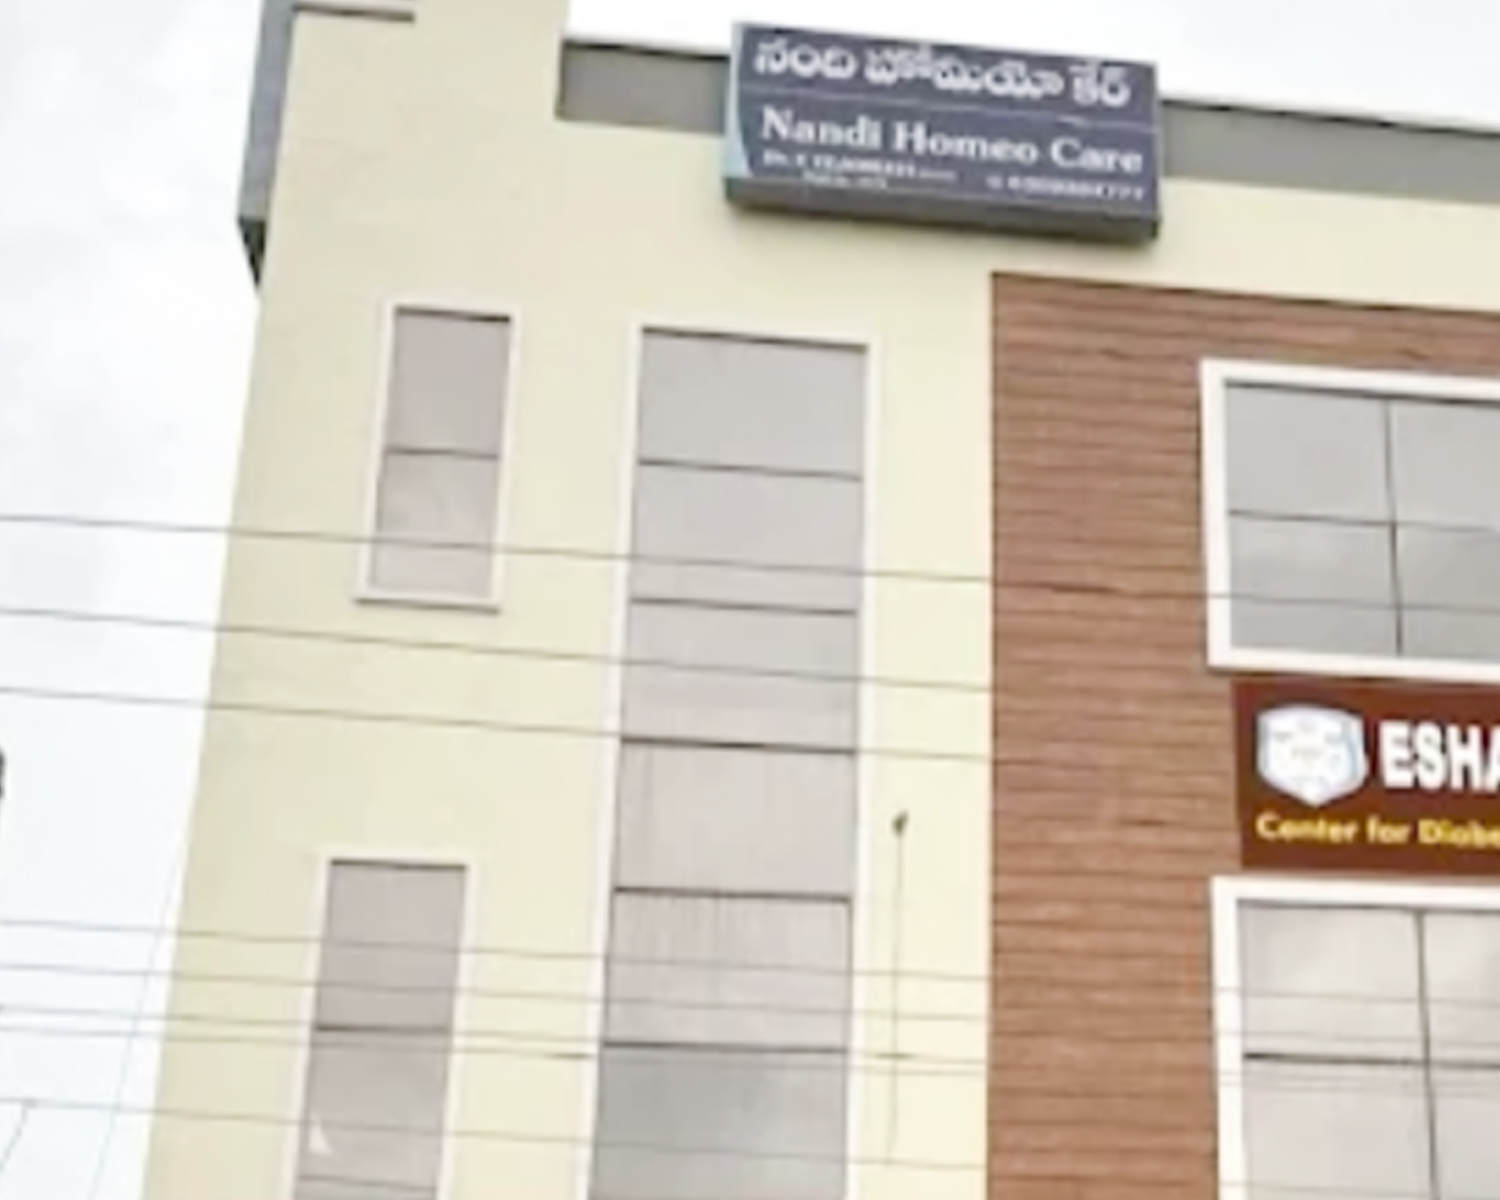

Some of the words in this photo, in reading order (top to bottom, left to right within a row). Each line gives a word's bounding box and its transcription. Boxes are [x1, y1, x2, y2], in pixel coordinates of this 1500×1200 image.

[761, 107, 884, 151] Nandi
[892, 120, 1040, 165] Homeo
[1049, 137, 1144, 174] Care
[1256, 811, 1357, 842] Center
[1366, 814, 1411, 844] for
